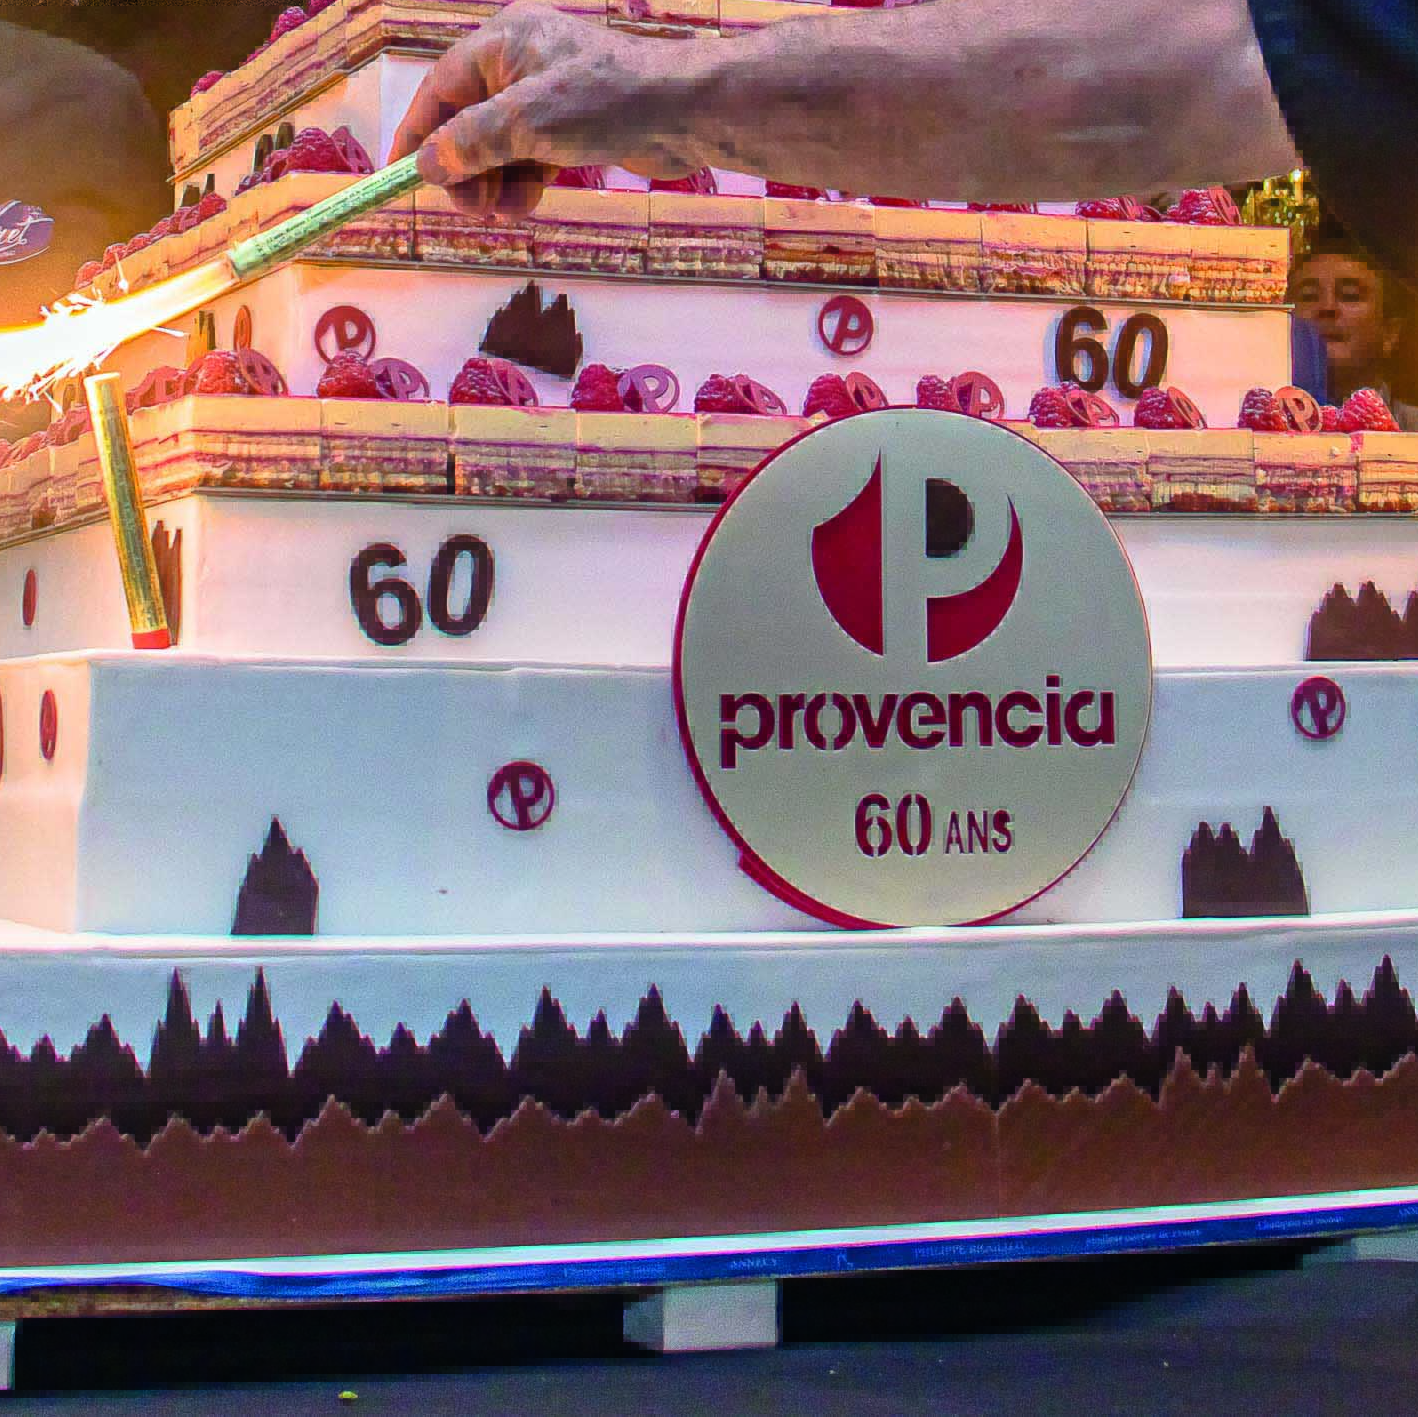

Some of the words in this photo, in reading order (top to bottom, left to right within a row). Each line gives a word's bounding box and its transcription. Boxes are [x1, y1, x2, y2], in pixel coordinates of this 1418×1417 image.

[1055, 305, 1169, 399] 60
[349, 533, 496, 646] 60
[720, 675, 1115, 769] provencia
[855, 793, 932, 857] 60
[944, 808, 1013, 854] ANS
